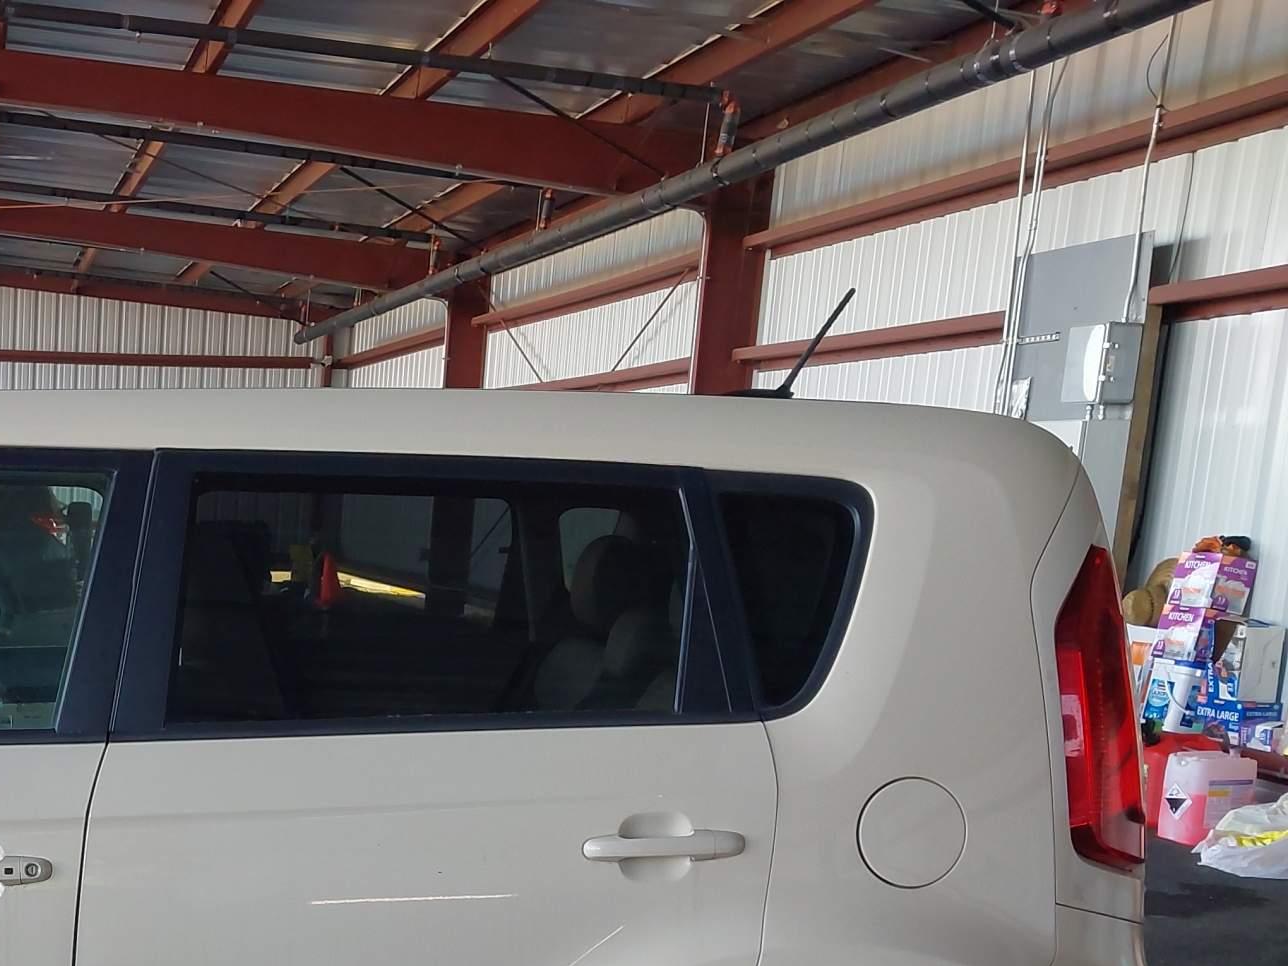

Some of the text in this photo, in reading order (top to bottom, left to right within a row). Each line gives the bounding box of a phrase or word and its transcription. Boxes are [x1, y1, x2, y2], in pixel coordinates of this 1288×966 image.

[1185, 560, 1211, 569] KITCHEN
[1168, 612, 1194, 622] KITCHEN
[1197, 706, 1239, 721] EXTRA LARGE
